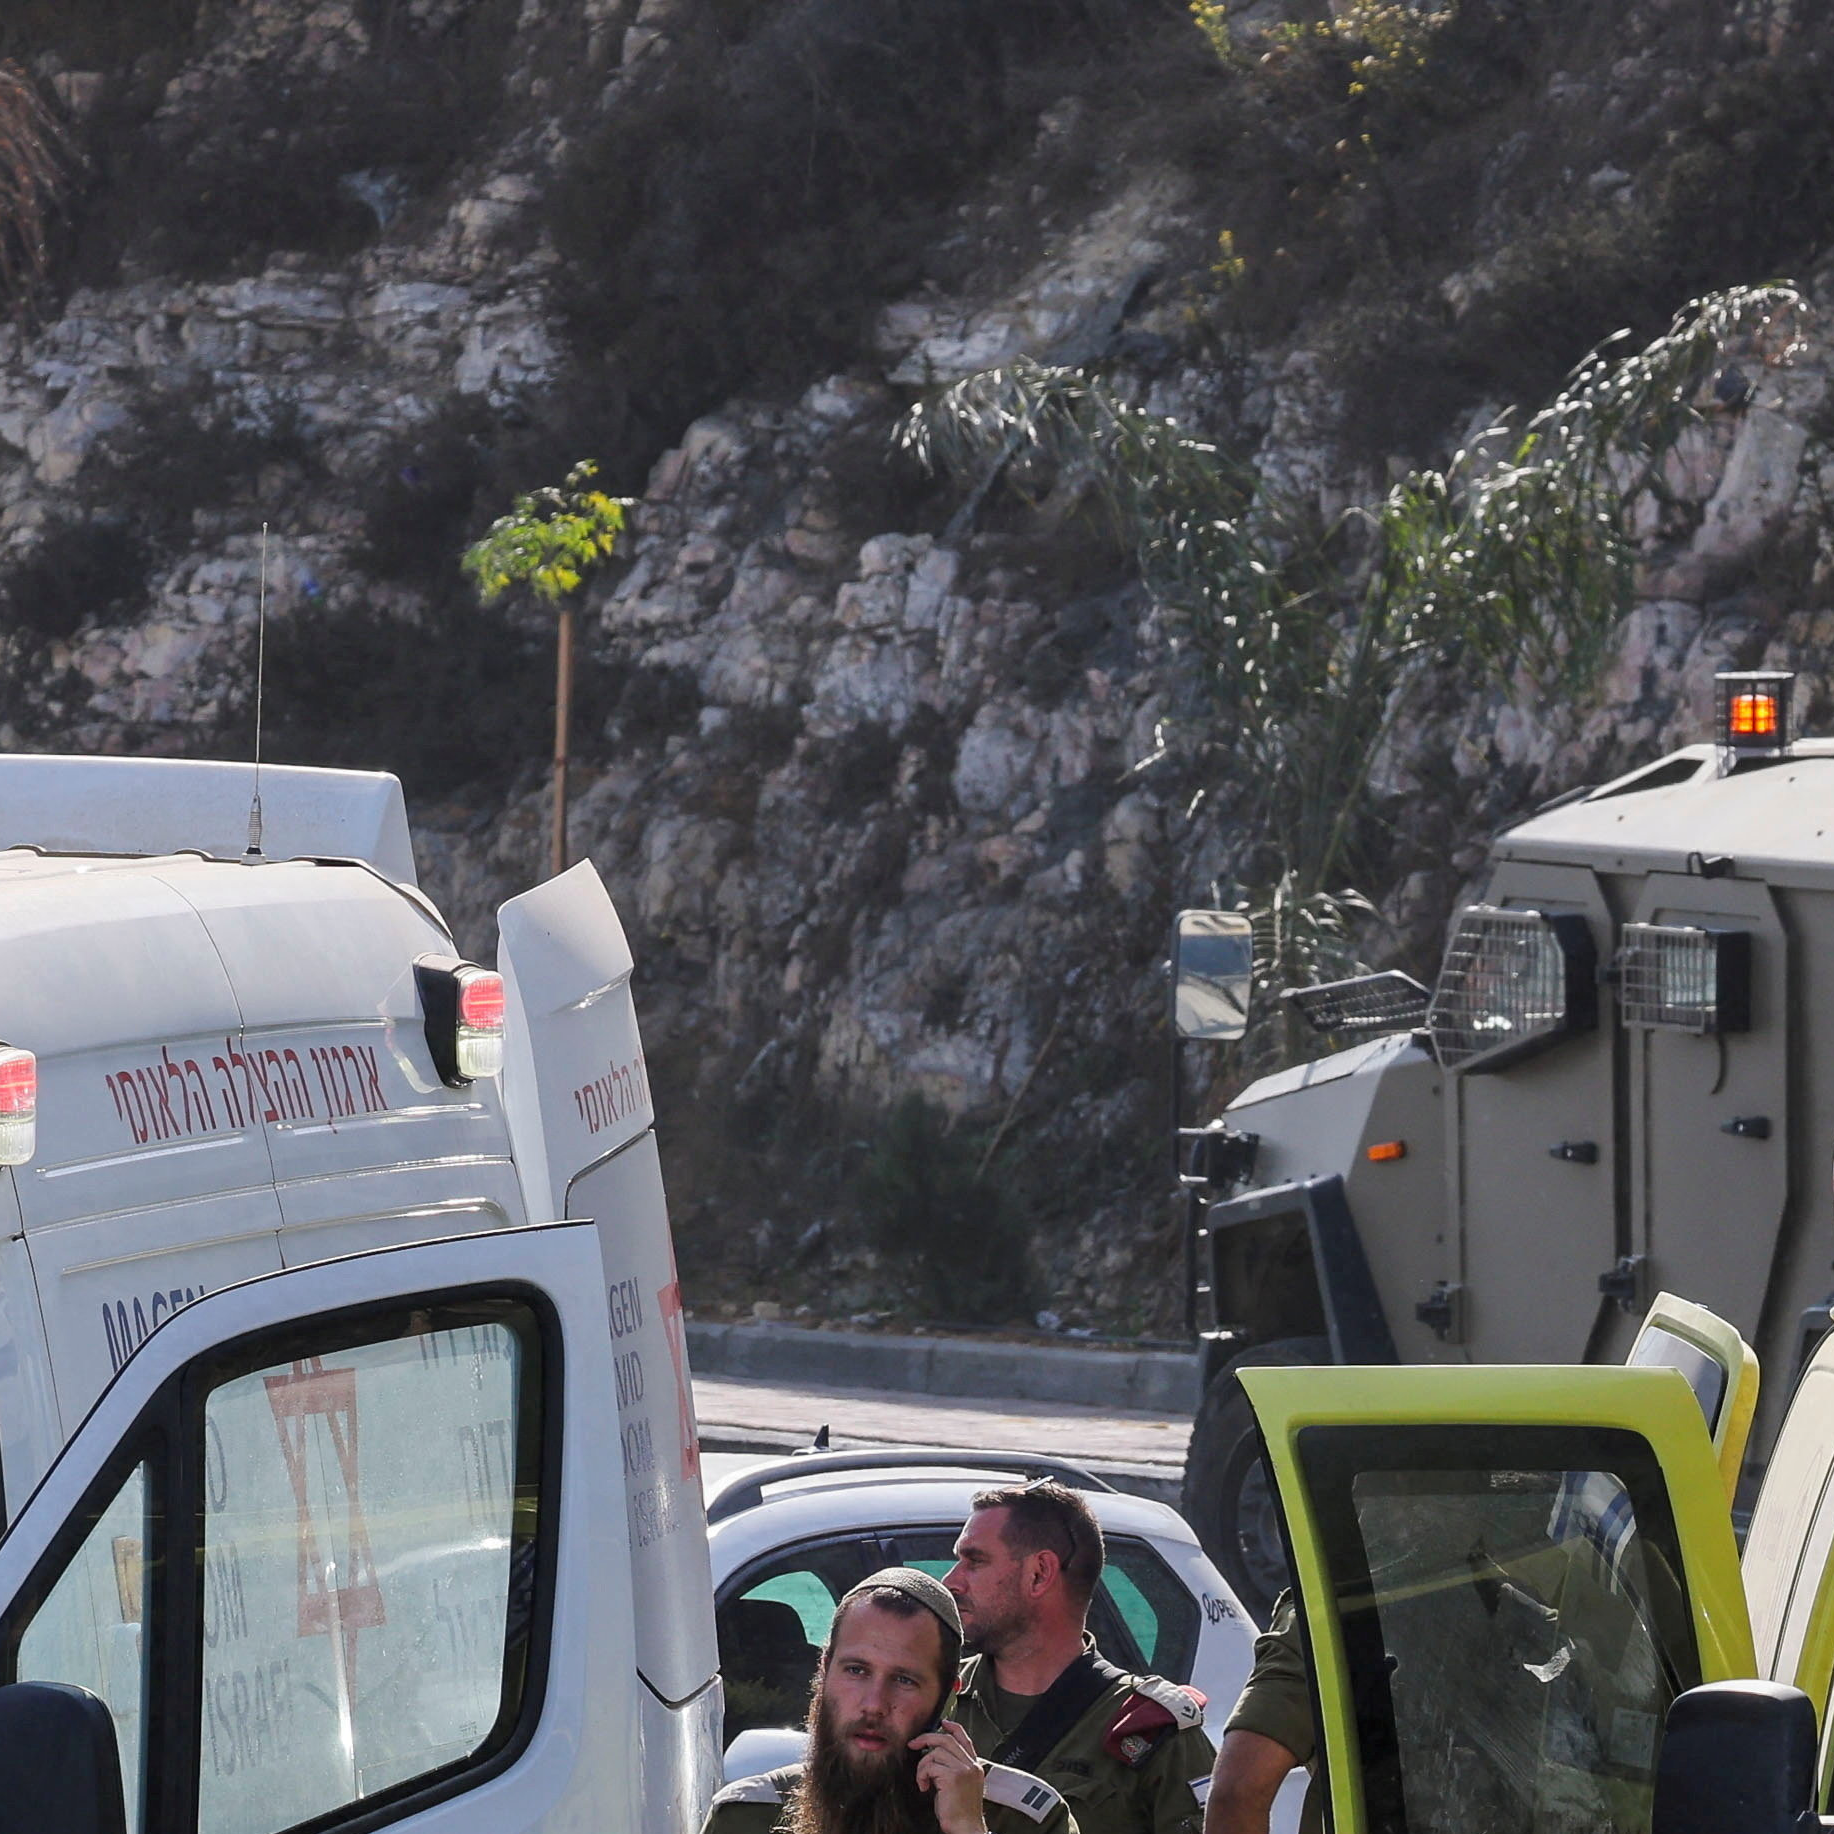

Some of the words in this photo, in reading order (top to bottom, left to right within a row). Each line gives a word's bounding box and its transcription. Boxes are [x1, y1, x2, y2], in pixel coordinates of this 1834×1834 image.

[105, 1044, 217, 1145] הלאומי
[212, 1035, 315, 1129] ההצלה
[309, 1045, 389, 1134] ארגון
[574, 1060, 636, 1134] הלאומי
[609, 1276, 643, 1340] GEN
